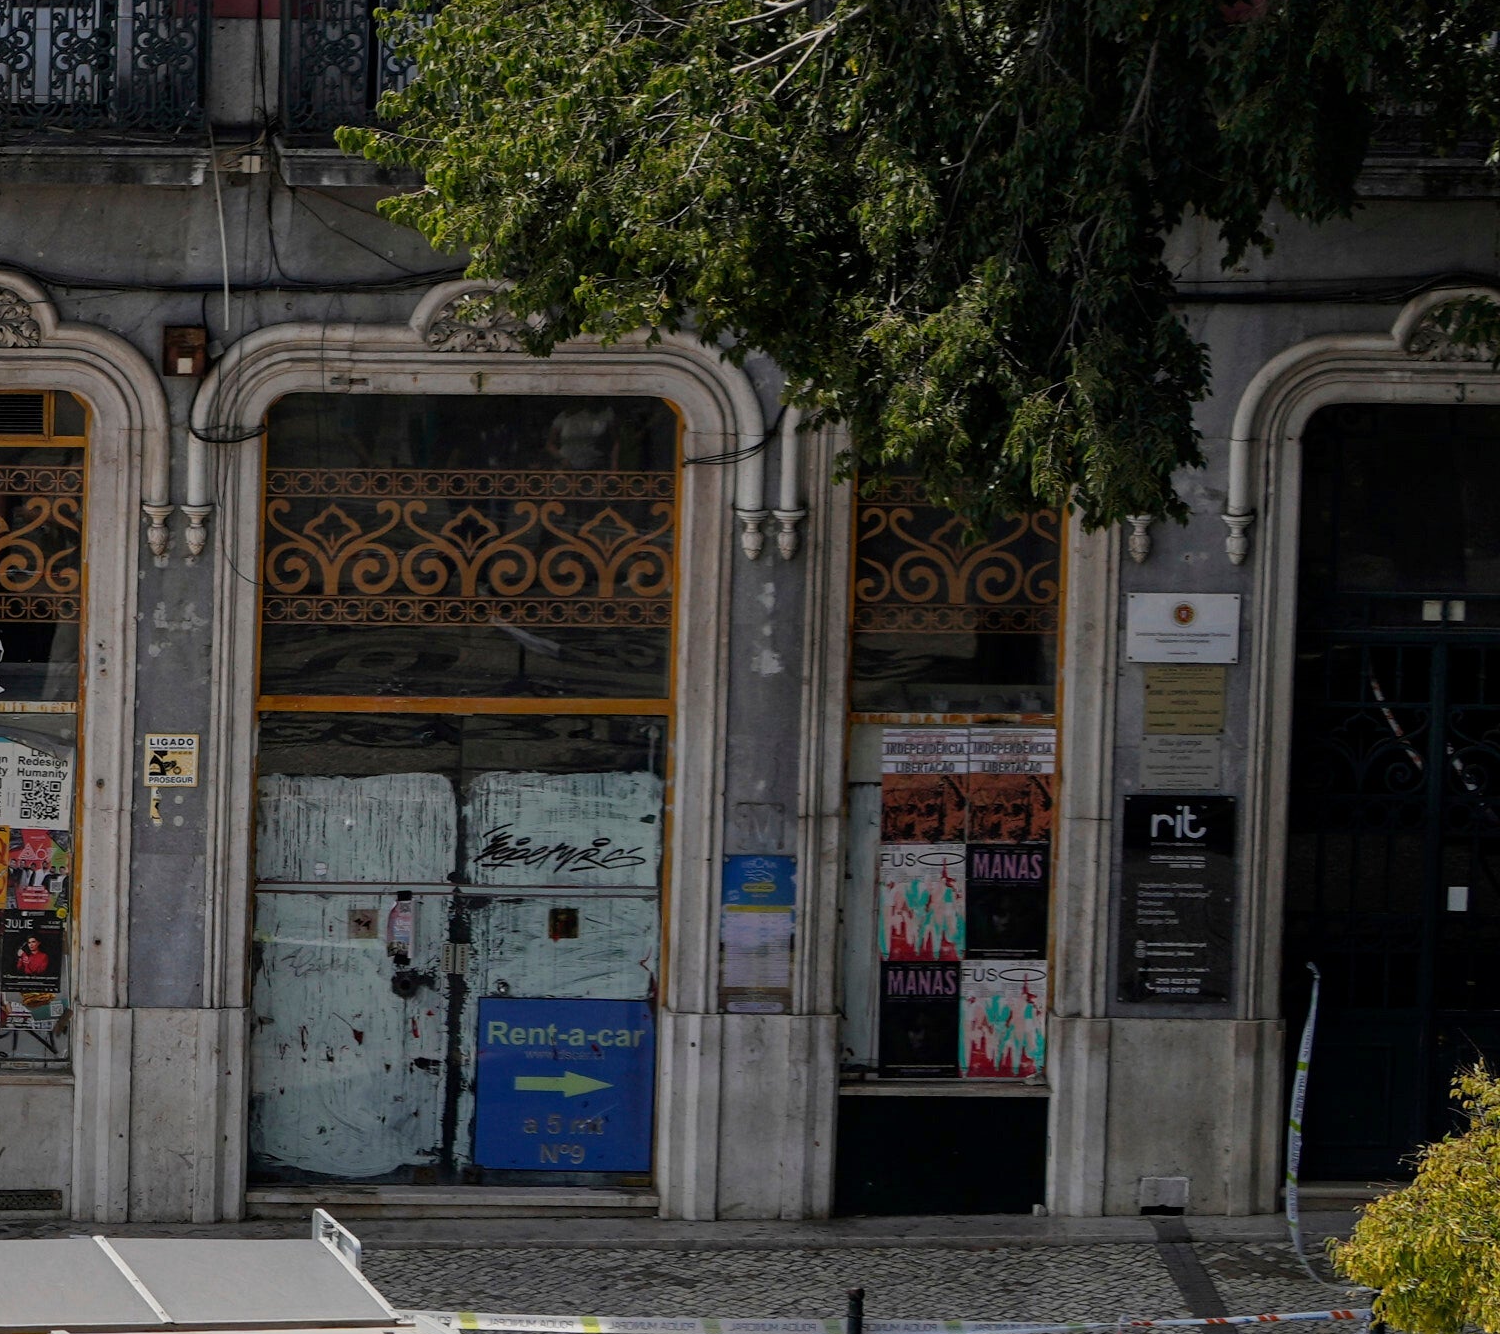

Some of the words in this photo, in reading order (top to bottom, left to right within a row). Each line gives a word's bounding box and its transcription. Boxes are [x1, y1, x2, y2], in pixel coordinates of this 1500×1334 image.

[150, 738, 194, 746] LIGADO
[18, 757, 68, 768] Redesign
[17, 769, 68, 780] Humanity
[1151, 806, 1207, 838] rit
[972, 853, 1042, 879] MANAS
[5, 919, 33, 929] JULIE
[887, 970, 957, 995] MANAS
[488, 1021, 645, 1047] Rent-a-car
[523, 1119, 537, 1134] a
[547, 1115, 561, 1134] 5
[540, 1144, 585, 1164] Nº9
